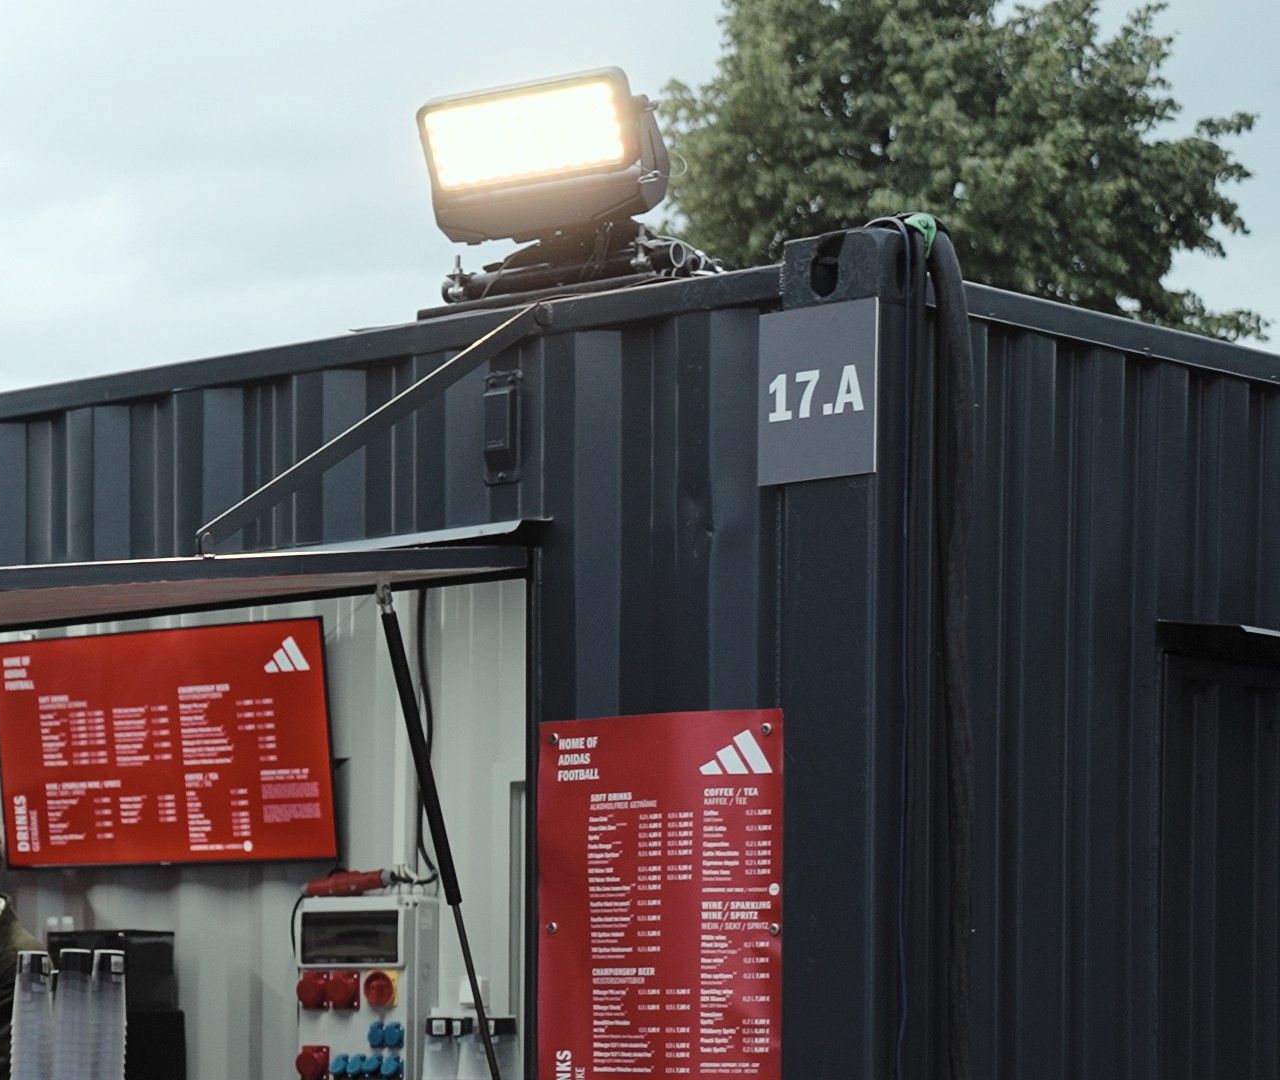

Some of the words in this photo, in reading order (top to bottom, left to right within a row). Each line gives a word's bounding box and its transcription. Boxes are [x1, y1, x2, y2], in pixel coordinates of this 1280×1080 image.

[769, 364, 864, 422] 17.A
[559, 737, 585, 750] HOME
[586, 736, 598, 748] OF
[558, 753, 590, 766] ADIDAS
[558, 769, 599, 781] FOOTBALL
[704, 788, 734, 796] COFFEE
[744, 787, 758, 796] TEA
[14, 795, 30, 852] DRINKS
[702, 901, 722, 910] WINE
[702, 911, 722, 920] WINE
[730, 911, 758, 920] SPRITZ
